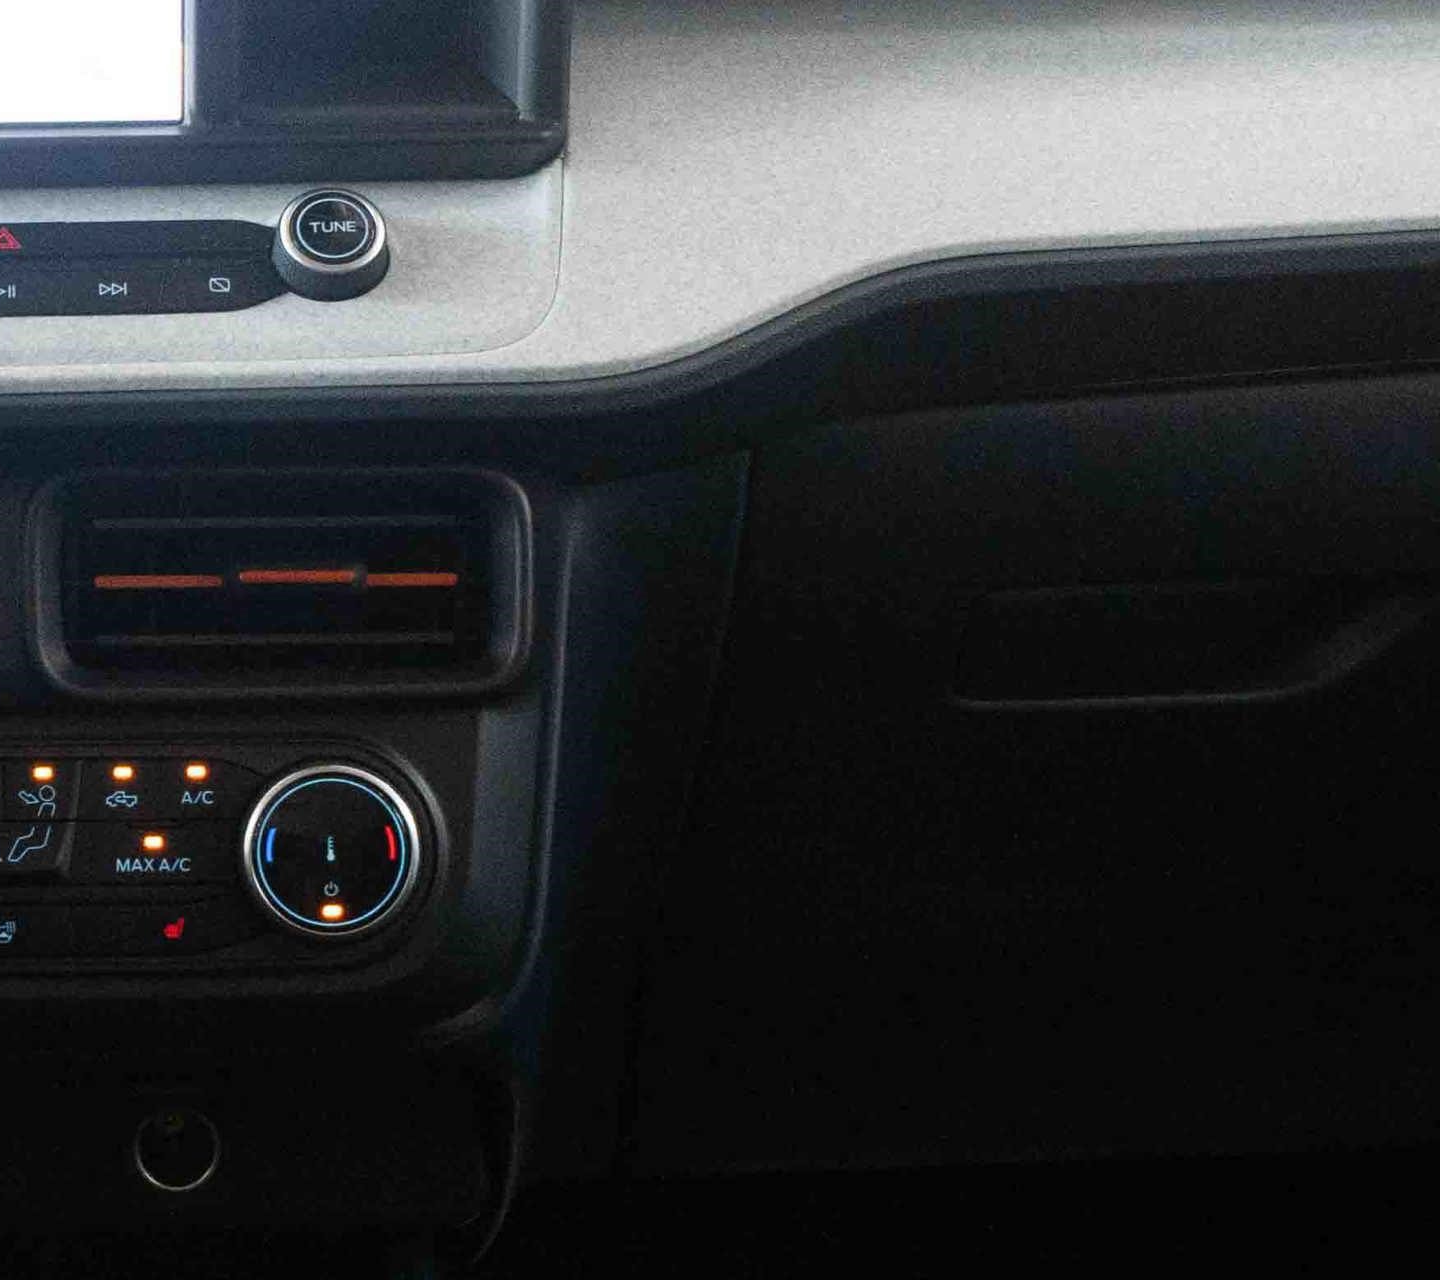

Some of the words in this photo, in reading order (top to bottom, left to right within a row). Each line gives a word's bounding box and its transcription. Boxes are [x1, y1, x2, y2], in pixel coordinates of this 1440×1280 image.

[308, 220, 357, 233] TUNE
[181, 790, 215, 805] A/C
[115, 857, 155, 873] MAX
[157, 857, 192, 873] A/C
